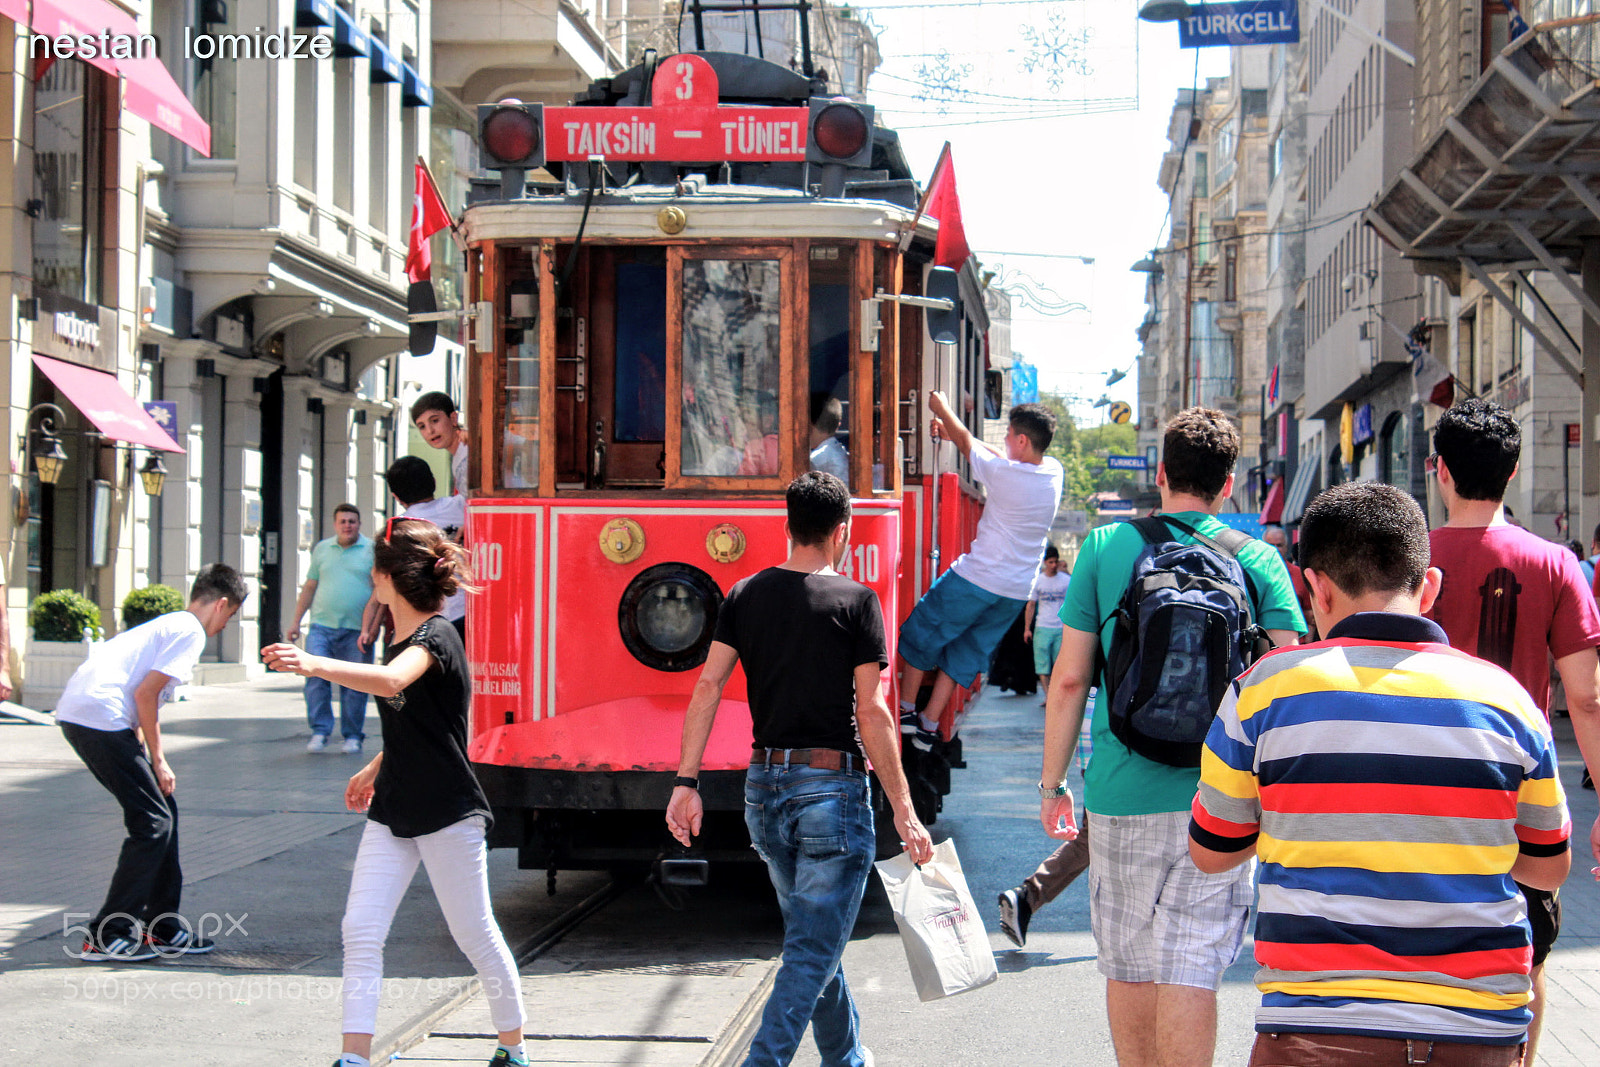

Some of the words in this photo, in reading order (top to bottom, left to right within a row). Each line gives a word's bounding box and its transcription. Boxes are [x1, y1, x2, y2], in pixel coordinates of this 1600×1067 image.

[1185, 10, 1292, 36] TURKCELL
[675, 61, 694, 100] 3
[563, 116, 656, 154] TAKSİM
[720, 116, 806, 154] TÜNEL
[471, 542, 503, 581] 410
[837, 544, 879, 583] 410
[488, 661, 520, 678] YASAK
